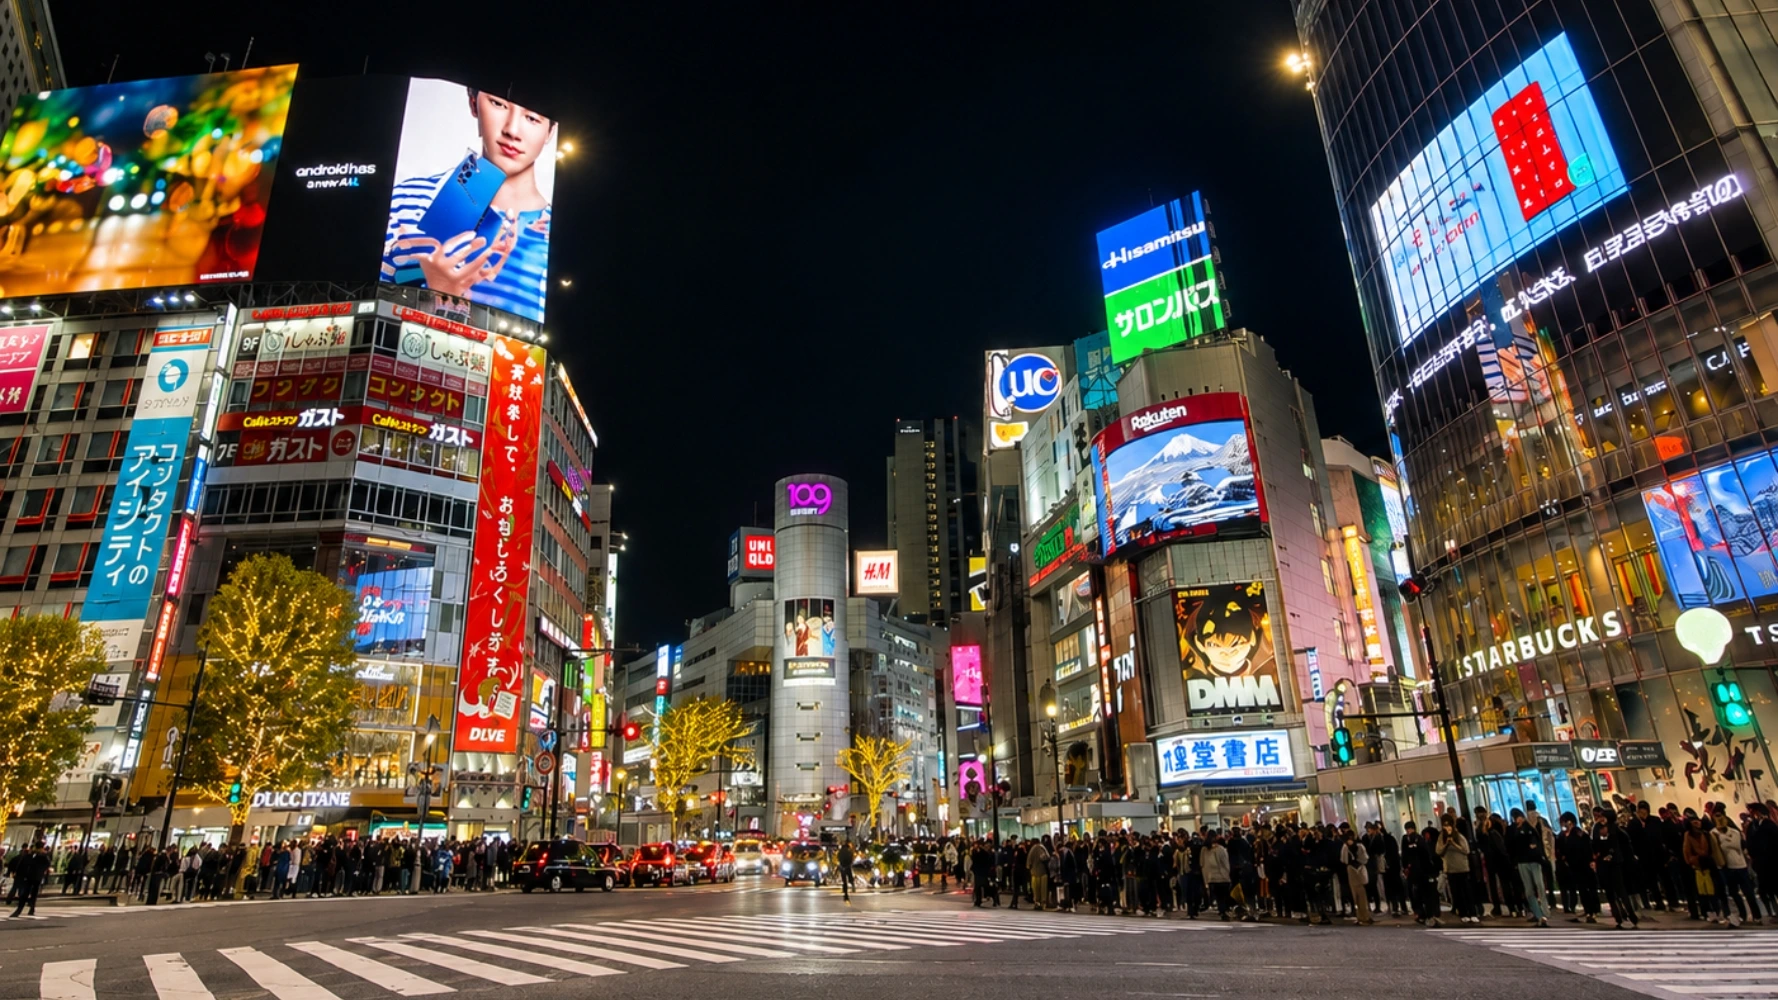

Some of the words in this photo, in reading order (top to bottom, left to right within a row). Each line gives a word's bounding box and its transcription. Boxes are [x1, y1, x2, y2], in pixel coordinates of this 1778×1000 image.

[1102, 220, 1206, 269] Hisamitsu
[1114, 278, 1220, 338] サロンパス
[369, 376, 460, 411] コンタクト
[297, 407, 345, 428] ガスト
[429, 422, 474, 447] ガスト
[1130, 405, 1197, 431] Rakuten
[267, 437, 323, 462] ガスト
[104, 444, 156, 587] アイシティ
[129, 443, 179, 586] コンタクトの
[787, 483, 832, 515] 109
[1462, 610, 1623, 678] STARBUCKS
[1186, 674, 1281, 710] DMM
